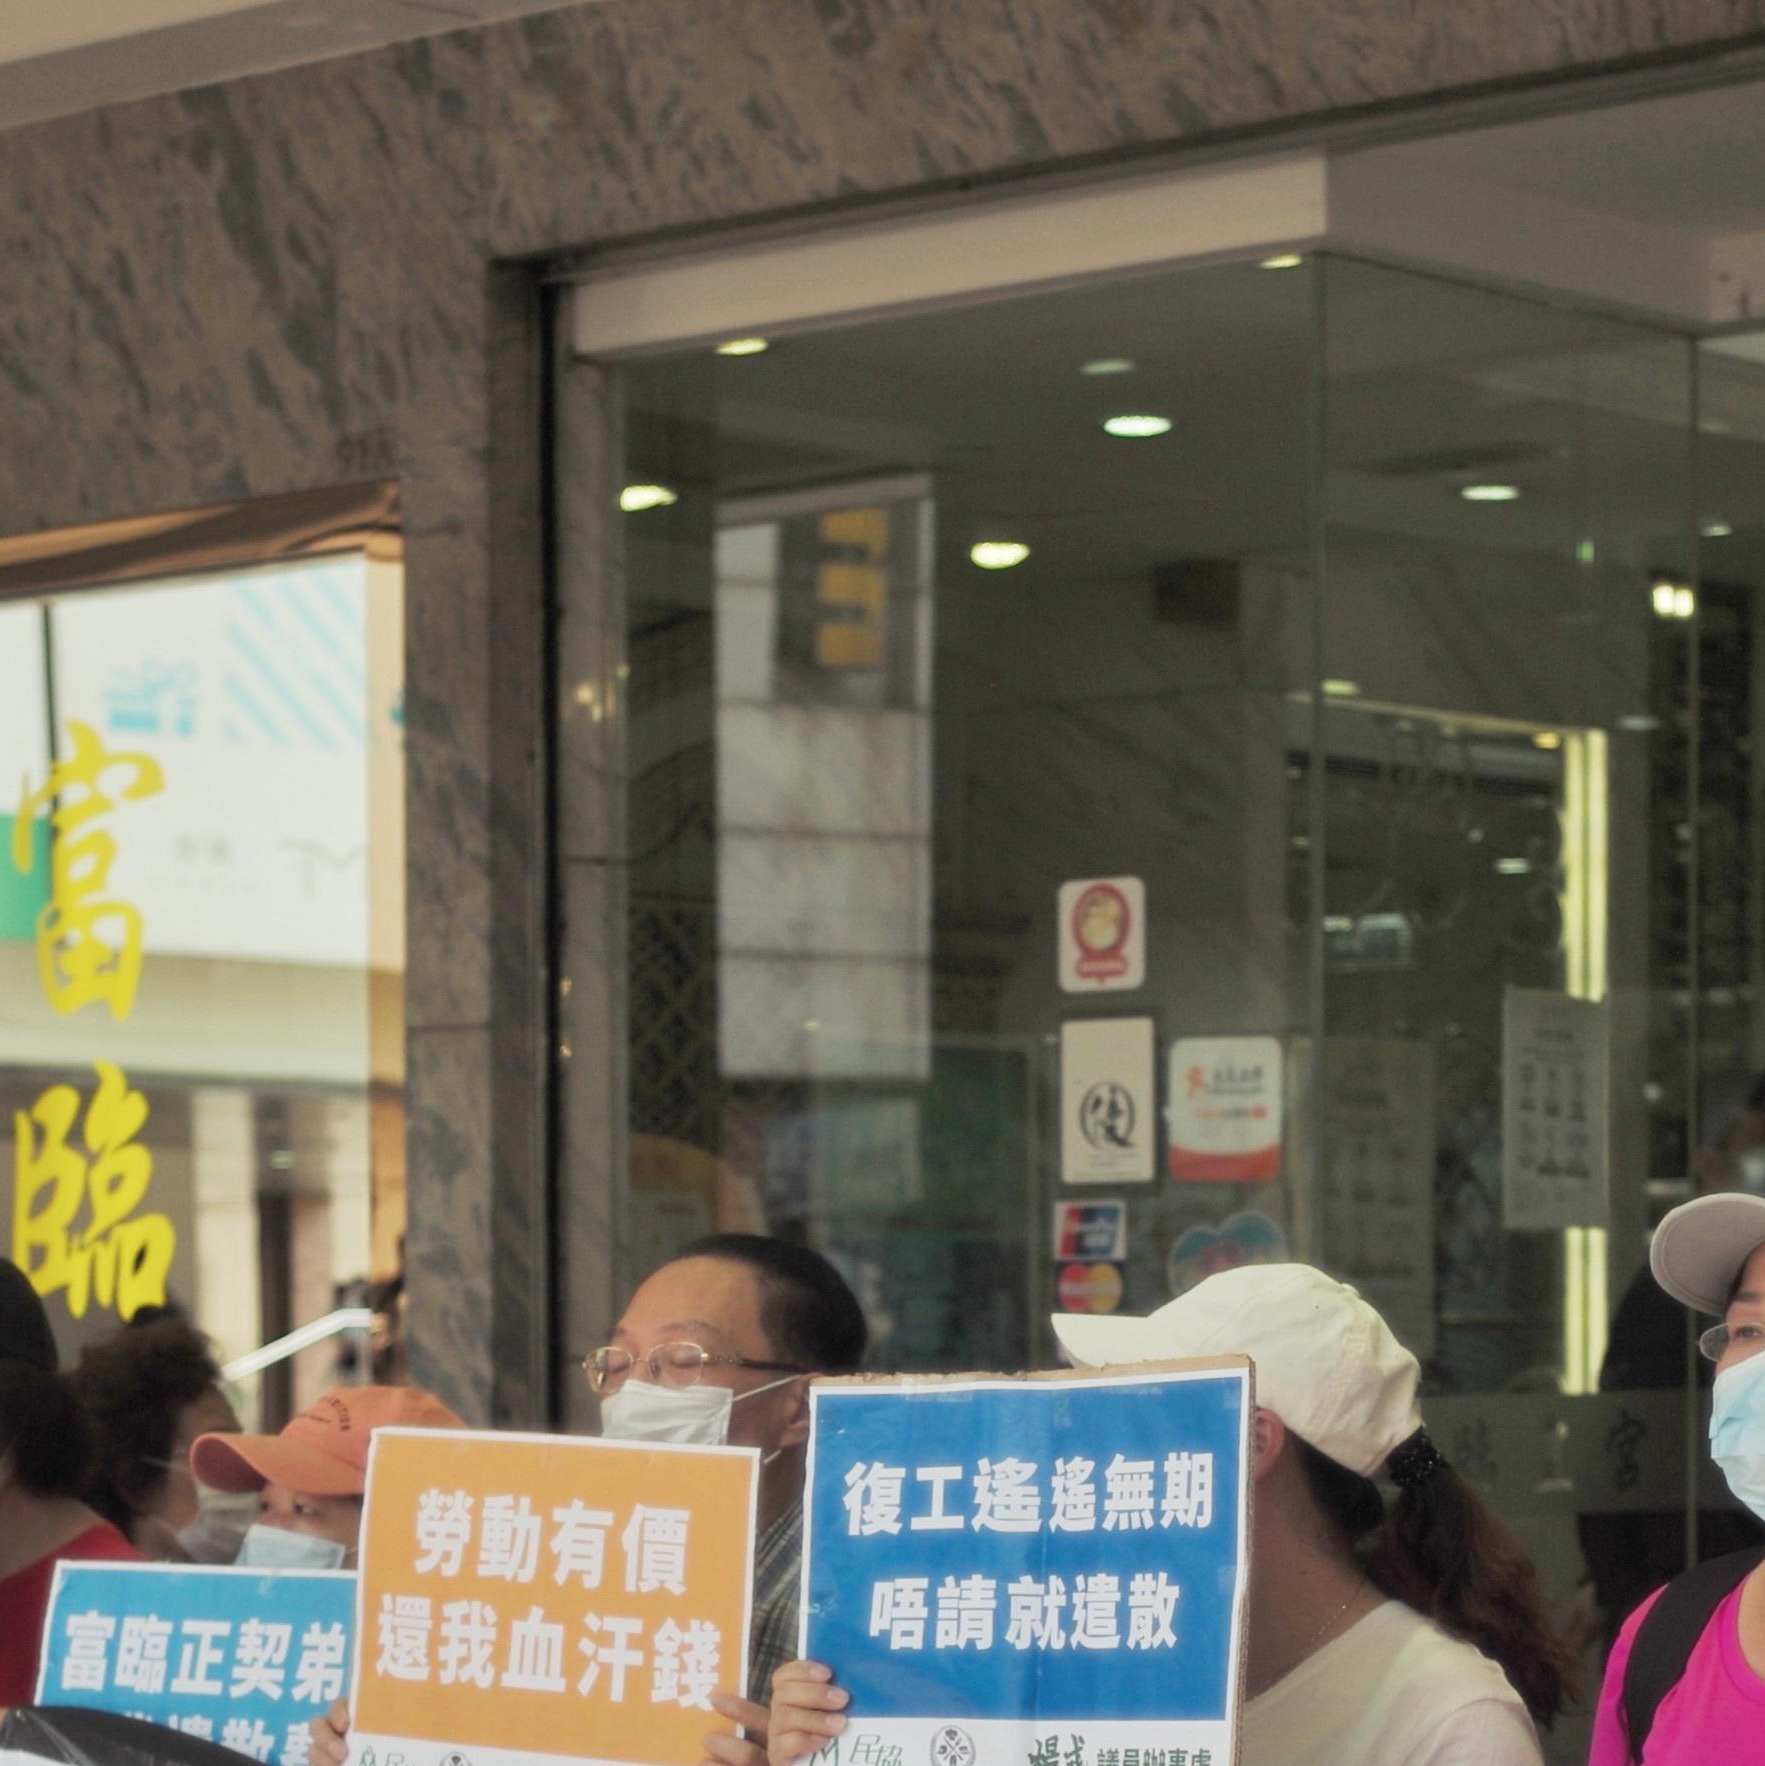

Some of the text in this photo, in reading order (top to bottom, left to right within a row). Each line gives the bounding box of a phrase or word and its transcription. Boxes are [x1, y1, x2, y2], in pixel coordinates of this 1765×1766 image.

[12, 719, 175, 1323] 富臨
[413, 1489, 692, 1596] 勞動有價
[843, 1452, 1214, 1537] 復工遙遙無期
[61, 1609, 348, 1704] 富臨正契弟
[376, 1592, 722, 1712] 還我血汗錢
[869, 1572, 1181, 1652] 唔請就遣散
